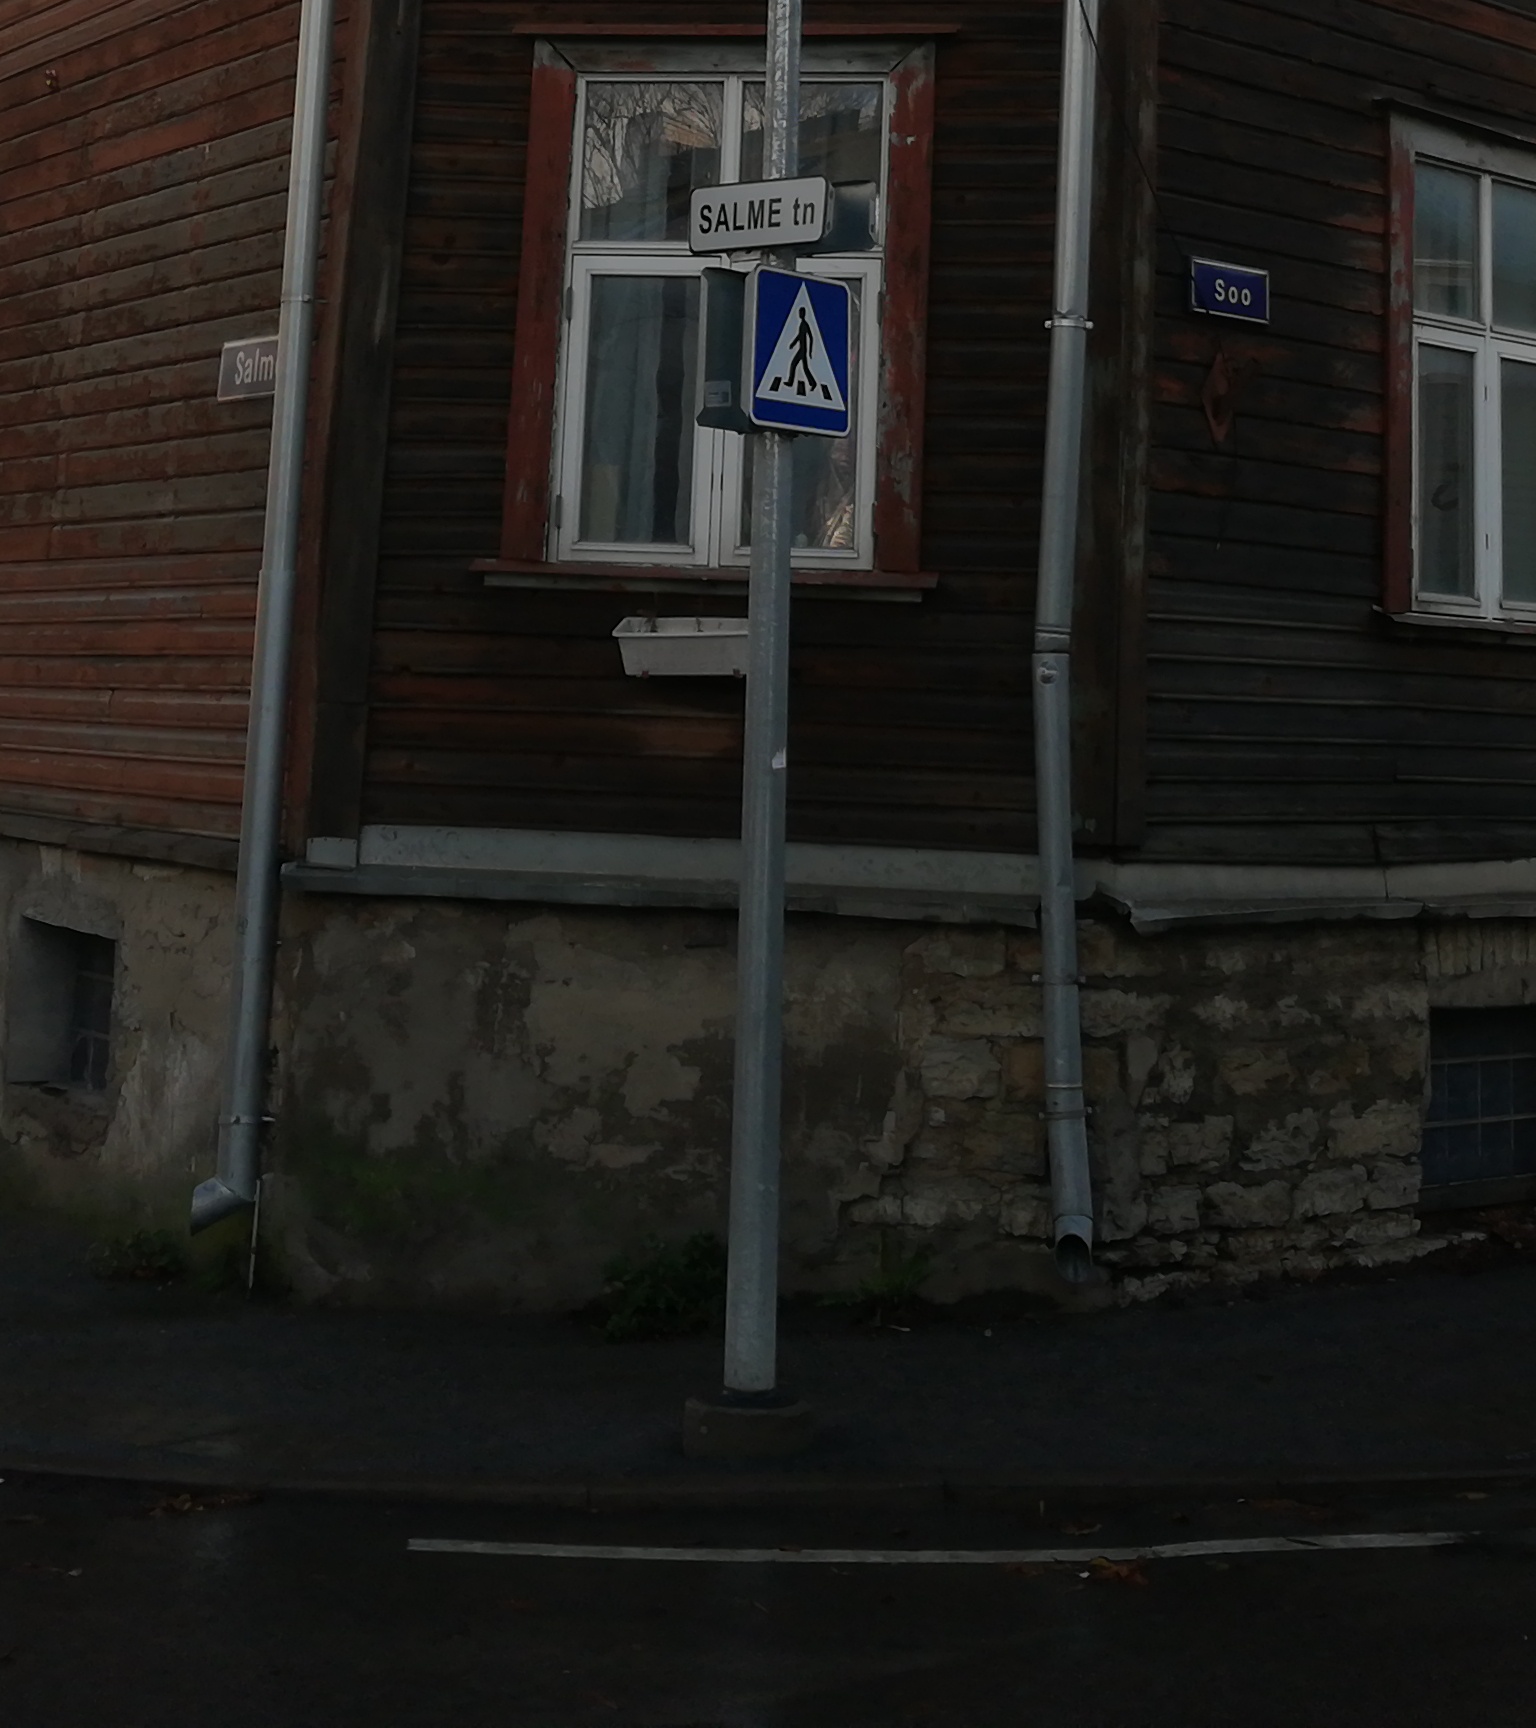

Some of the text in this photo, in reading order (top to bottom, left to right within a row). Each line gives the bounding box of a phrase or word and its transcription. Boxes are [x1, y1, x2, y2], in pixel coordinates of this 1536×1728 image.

[698, 196, 816, 235] SALME tn
[1214, 278, 1252, 306] Soo
